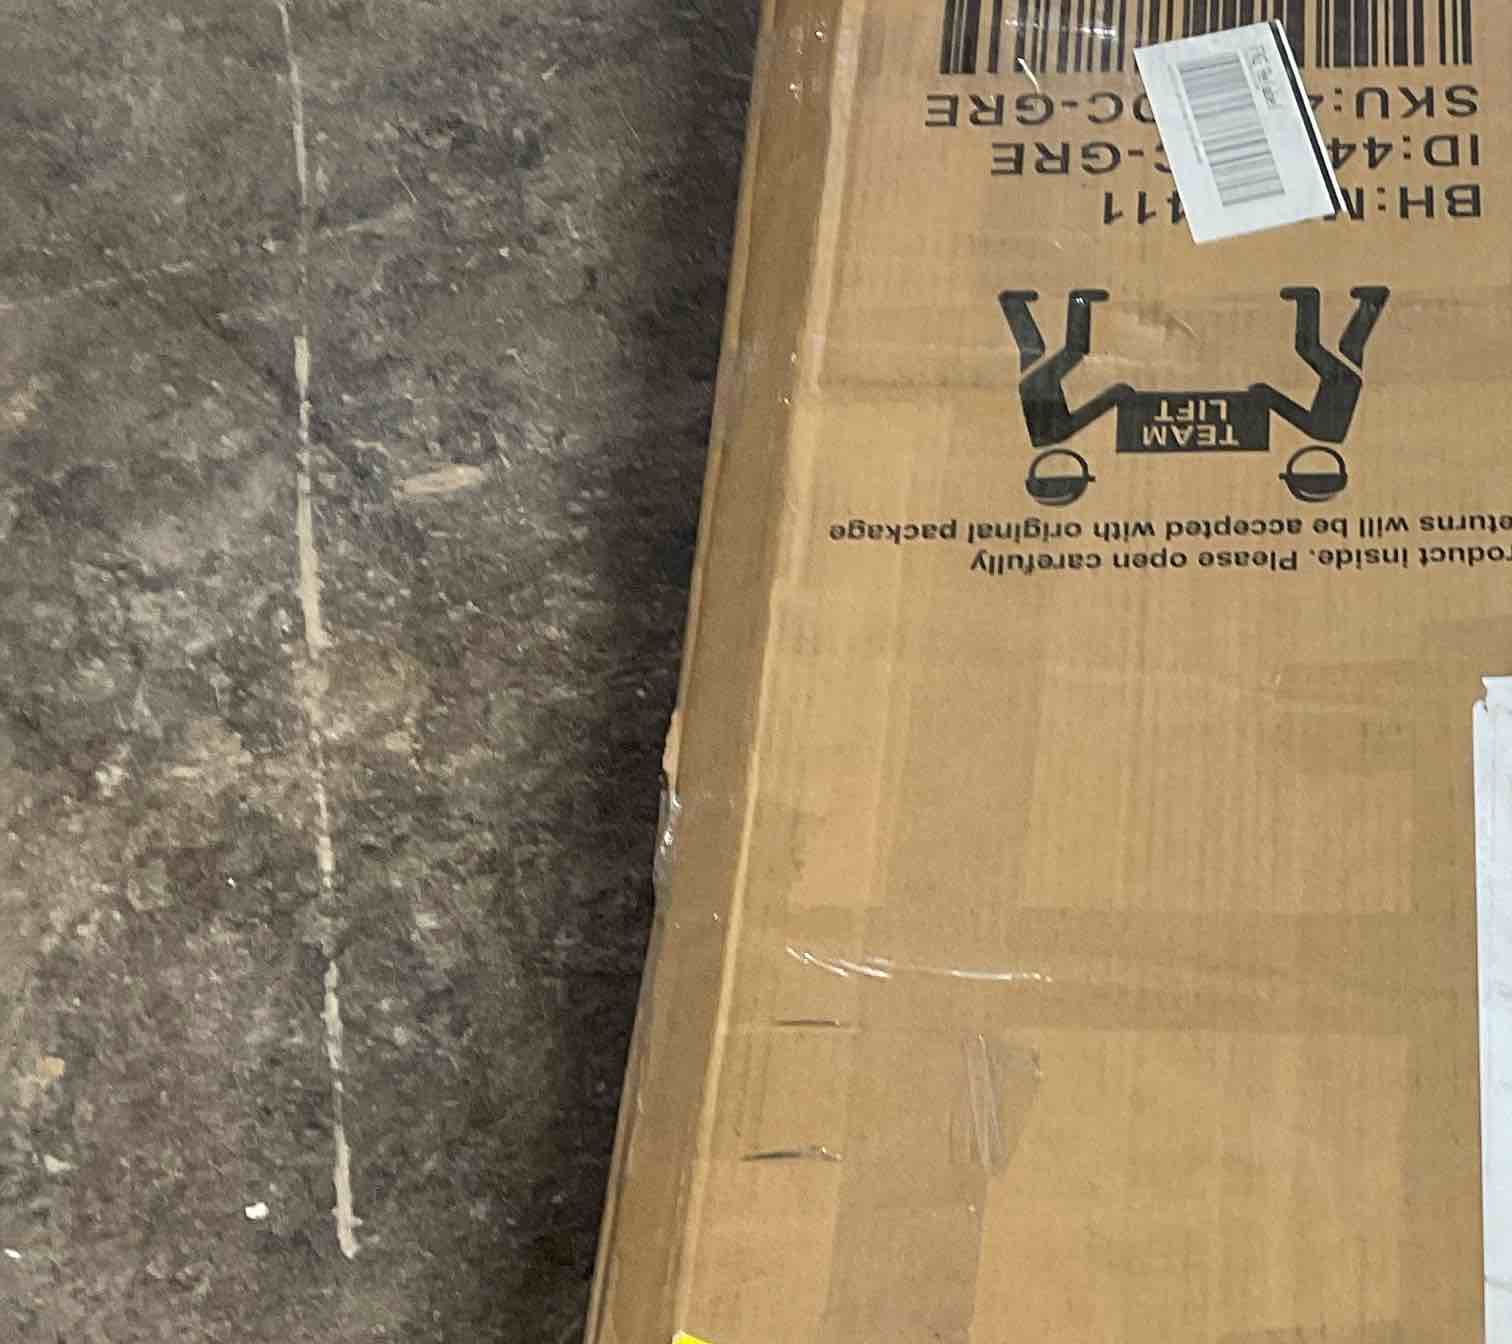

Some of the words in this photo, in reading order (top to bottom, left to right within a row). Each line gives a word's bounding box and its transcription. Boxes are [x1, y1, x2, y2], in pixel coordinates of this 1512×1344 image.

[1154, 399, 1228, 422] LIFT
[1143, 423, 1239, 446] TEAM
[829, 519, 958, 544] package
[968, 517, 1083, 543] original
[1094, 518, 1156, 542] with
[1166, 515, 1303, 540] accepted
[1312, 516, 1348, 538] be
[1359, 515, 1409, 538] will
[970, 549, 1102, 575] carefully
[1112, 548, 1187, 569] open
[1198, 550, 1297, 571] Please
[1309, 546, 1409, 569] inside.
